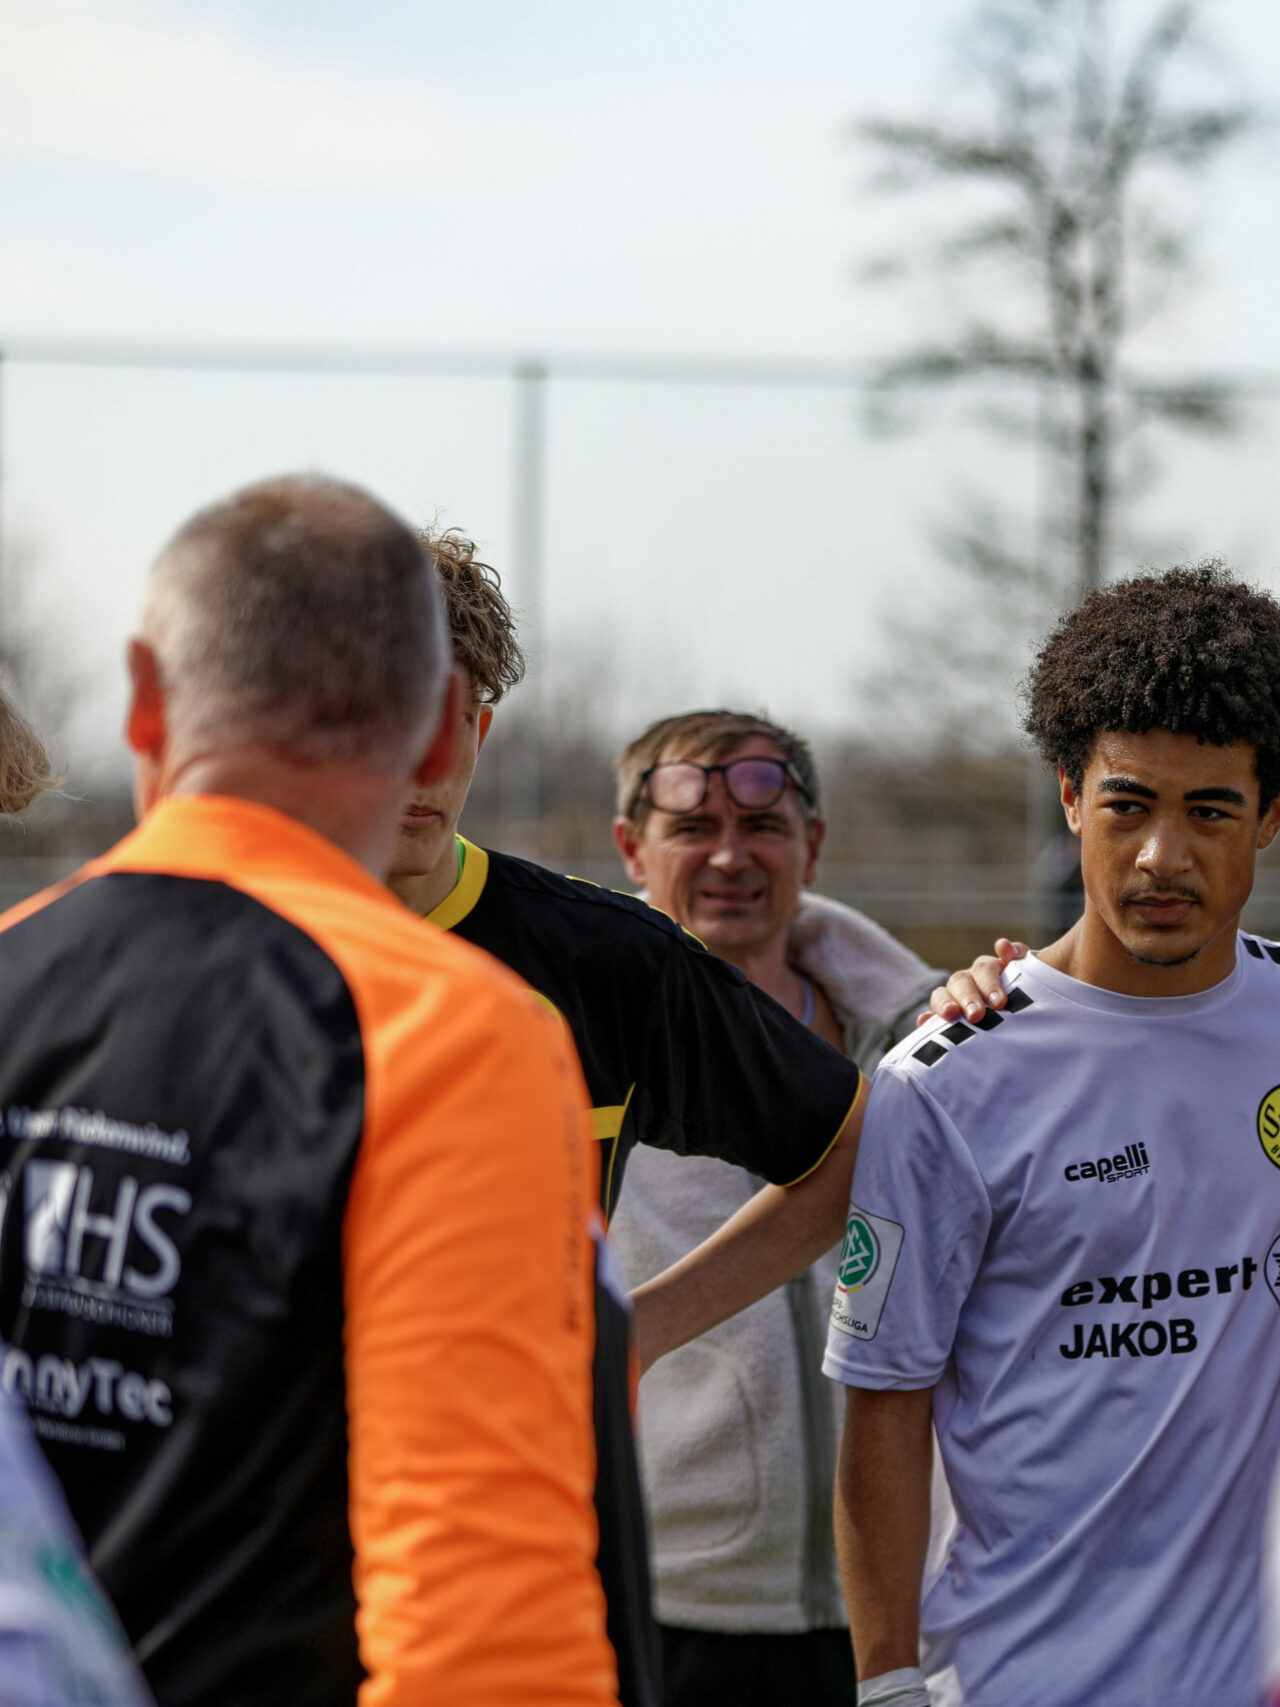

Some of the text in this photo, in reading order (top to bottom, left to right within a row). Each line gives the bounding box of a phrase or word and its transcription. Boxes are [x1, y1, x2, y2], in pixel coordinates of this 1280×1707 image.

[1064, 1142, 1149, 1182] capelli
[1106, 1165, 1150, 1183] SPORT
[1060, 1257, 1257, 1309] expert
[1059, 1318, 1198, 1359] JAKOB
